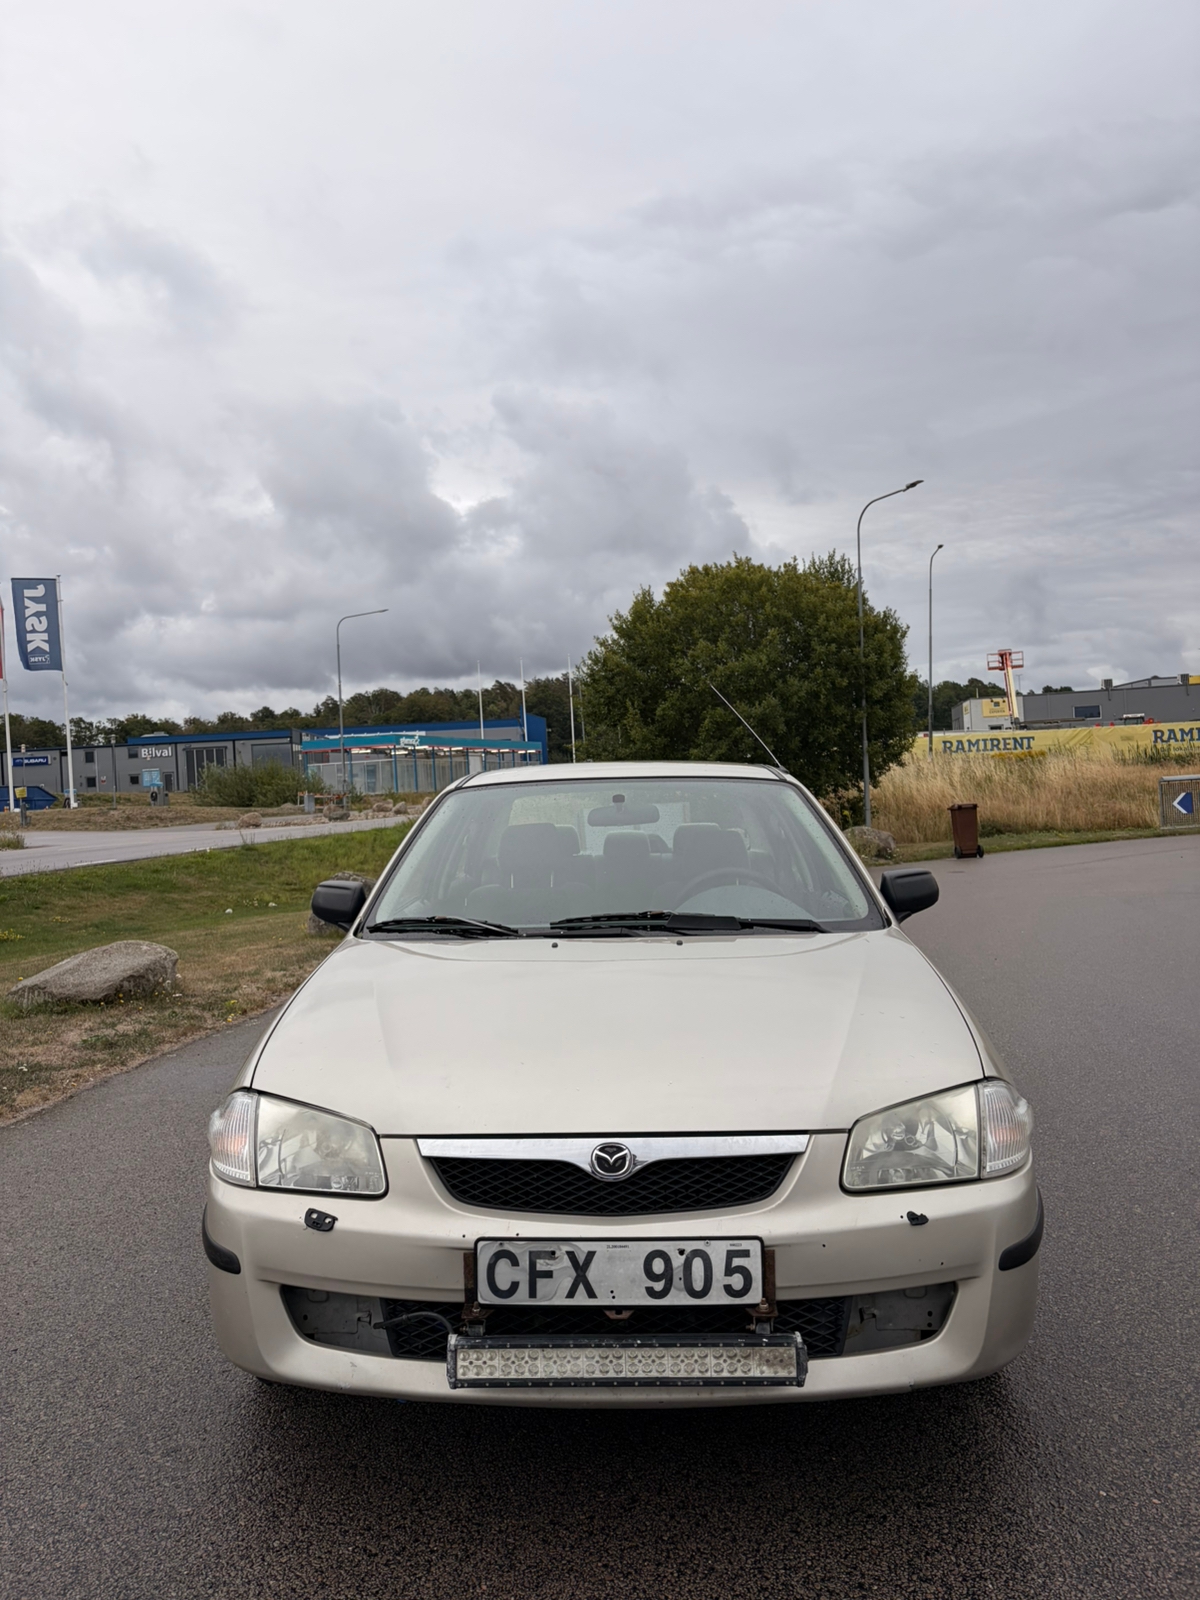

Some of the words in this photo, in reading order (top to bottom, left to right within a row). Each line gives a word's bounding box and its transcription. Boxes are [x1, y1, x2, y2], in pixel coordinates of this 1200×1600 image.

[141, 747, 172, 758] Bilval
[942, 736, 1035, 753] RAMIRENT
[486, 1249, 598, 1299] CFX
[643, 1249, 753, 1300] 905
